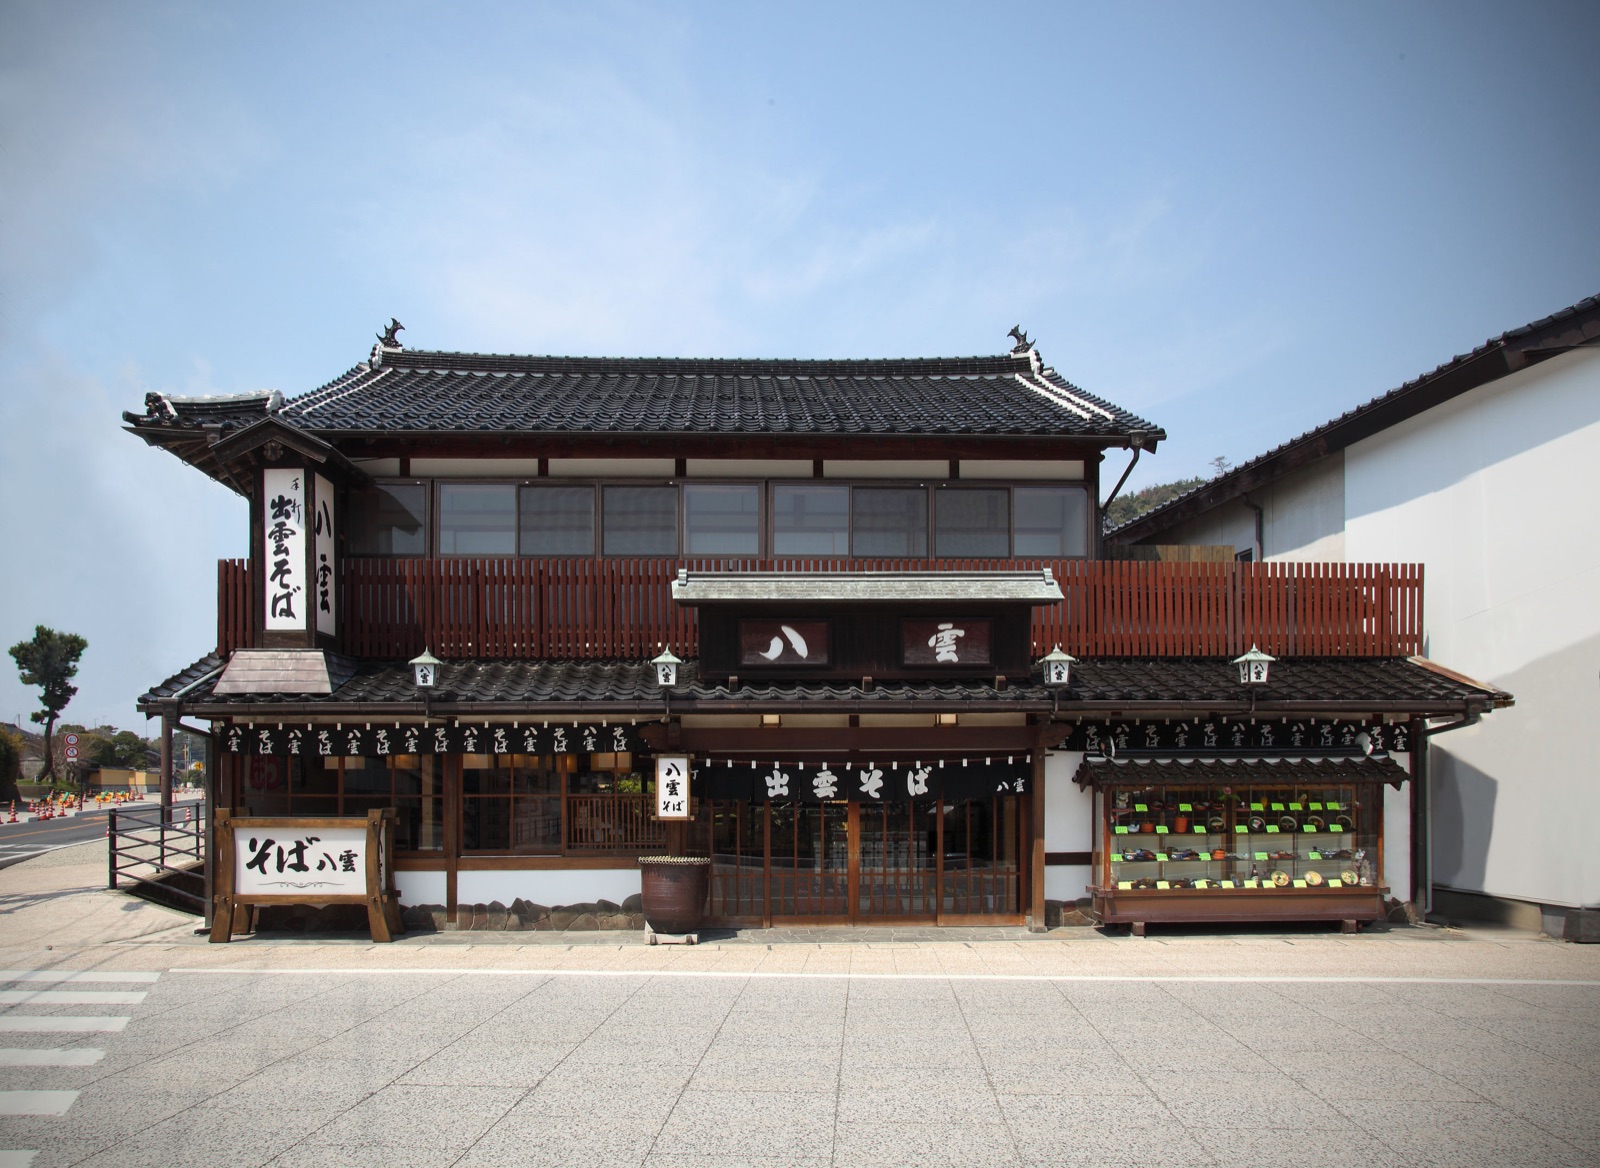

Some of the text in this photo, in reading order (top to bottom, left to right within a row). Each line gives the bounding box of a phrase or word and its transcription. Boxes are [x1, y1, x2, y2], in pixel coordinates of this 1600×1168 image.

[268, 495, 301, 620] 出雲そば
[315, 500, 332, 615] 八雲
[420, 666, 430, 684] 八雲
[662, 665, 671, 683] 八雲
[1054, 662, 1065, 681] 八雲
[1254, 662, 1264, 681] 八雲
[228, 726, 242, 752] 八雲
[258, 729, 274, 755] そば
[288, 729, 302, 755] 八雲
[317, 730, 333, 755] そば
[347, 729, 361, 755] 八雲
[376, 729, 392, 755] そば
[405, 727, 419, 753] 八雲
[434, 727, 449, 753] そば
[464, 726, 478, 752] 八雲
[493, 728, 509, 753] そば
[523, 726, 538, 752] 八雲
[553, 727, 569, 753] そば
[583, 726, 597, 752] 八雲
[612, 726, 627, 752] そば
[1086, 725, 1100, 750] そば
[1115, 723, 1130, 749] 八雲
[1145, 724, 1161, 748] そば
[1175, 722, 1189, 748] 八雲
[1204, 723, 1219, 747] そば
[1231, 722, 1246, 747] 八雲
[1260, 724, 1273, 746] そば
[1291, 722, 1305, 746] 八雲
[1320, 724, 1333, 746] そば
[1341, 724, 1356, 746] 八雲
[1393, 725, 1408, 750] 八雲
[665, 762, 681, 796] 八雲
[765, 766, 933, 798] 出雲そば
[996, 778, 1025, 792] 八雲
[662, 800, 685, 812] そば
[246, 836, 321, 875] そば
[316, 849, 358, 872] 八雲
